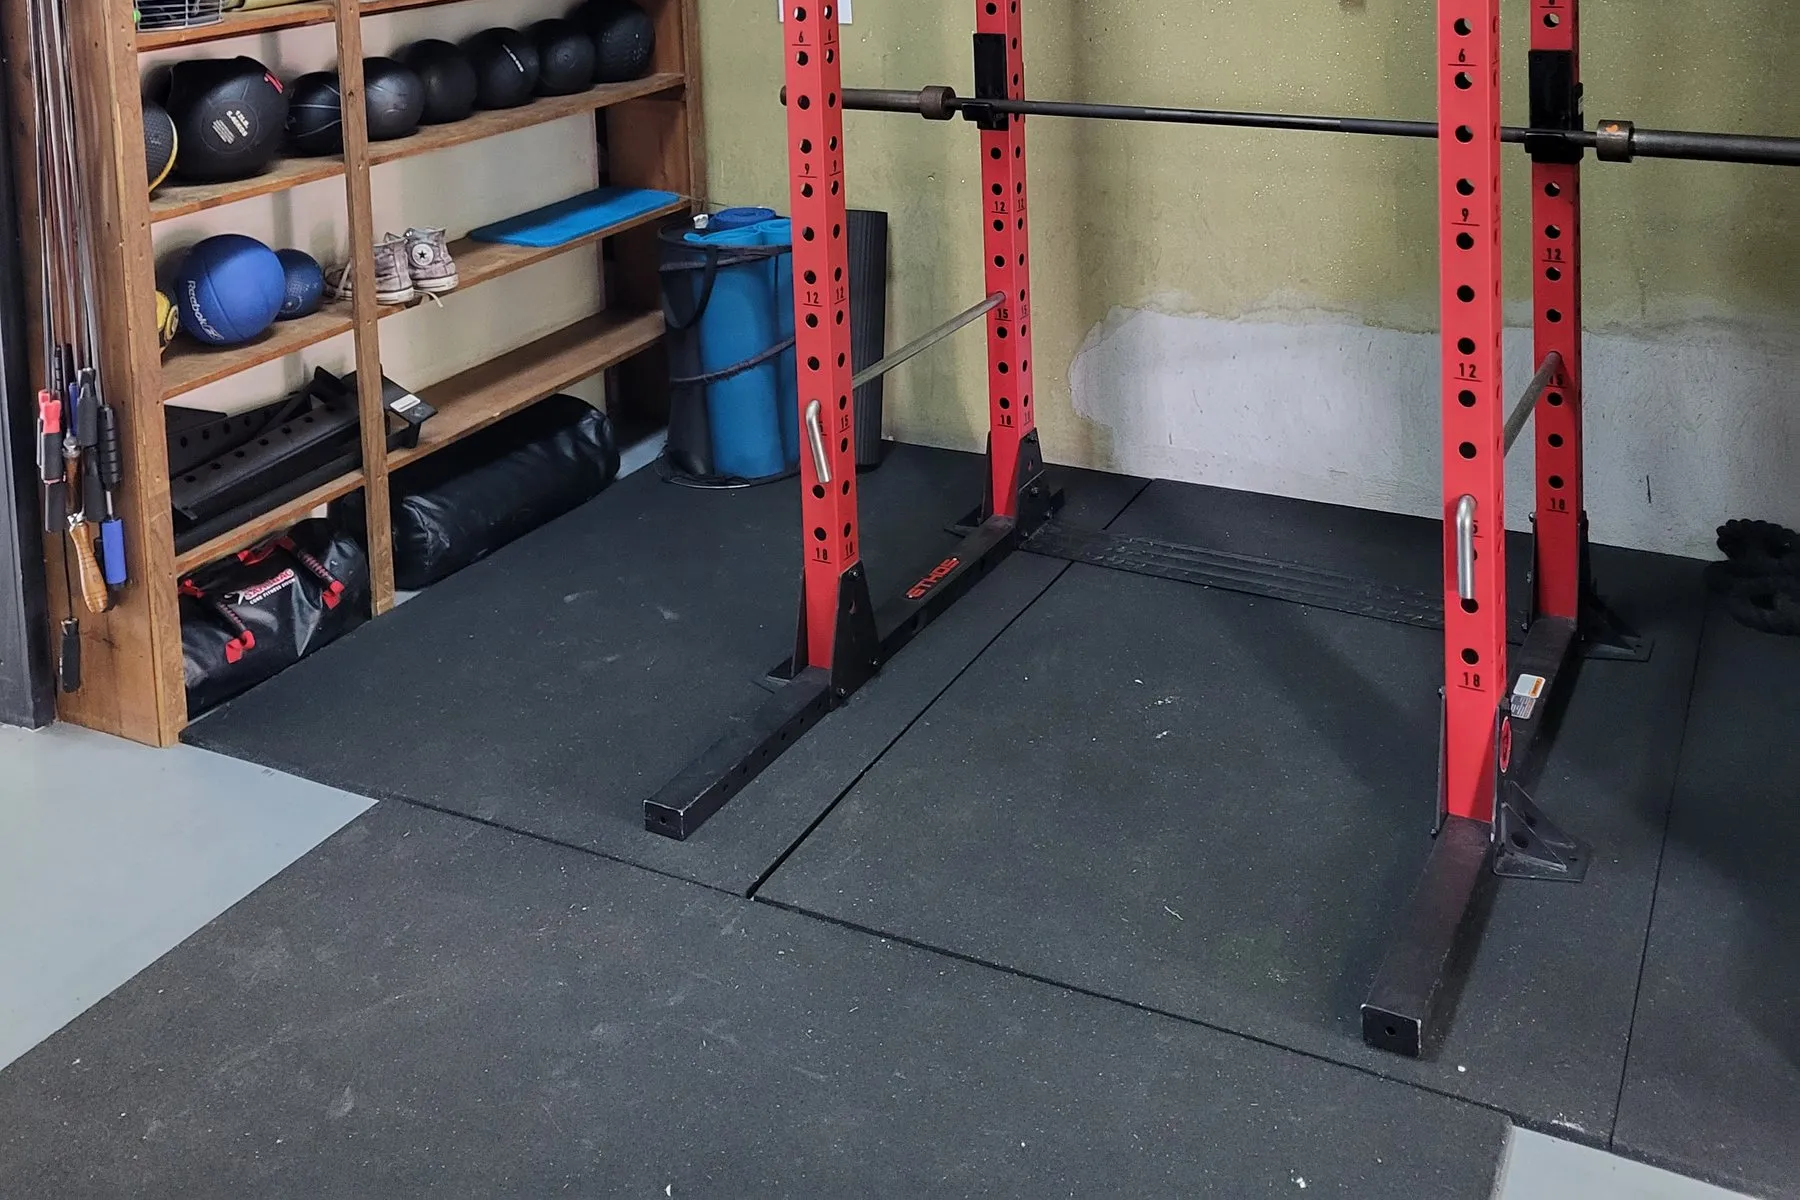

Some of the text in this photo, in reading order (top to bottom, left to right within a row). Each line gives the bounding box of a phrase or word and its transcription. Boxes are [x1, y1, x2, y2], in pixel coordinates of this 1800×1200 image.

[799, 30, 804, 43] 6
[1459, 48, 1465, 63] 6
[804, 162, 810, 175] 9
[995, 200, 1005, 211] 12
[1461, 207, 1469, 222] 9
[1546, 247, 1562, 260] 12
[187, 280, 208, 327] Reebok
[806, 291, 819, 304] 12
[997, 308, 1009, 319] 15
[1458, 362, 1477, 378] 12
[262, 585, 282, 598] FITNESS
[1463, 671, 1480, 688] 18
